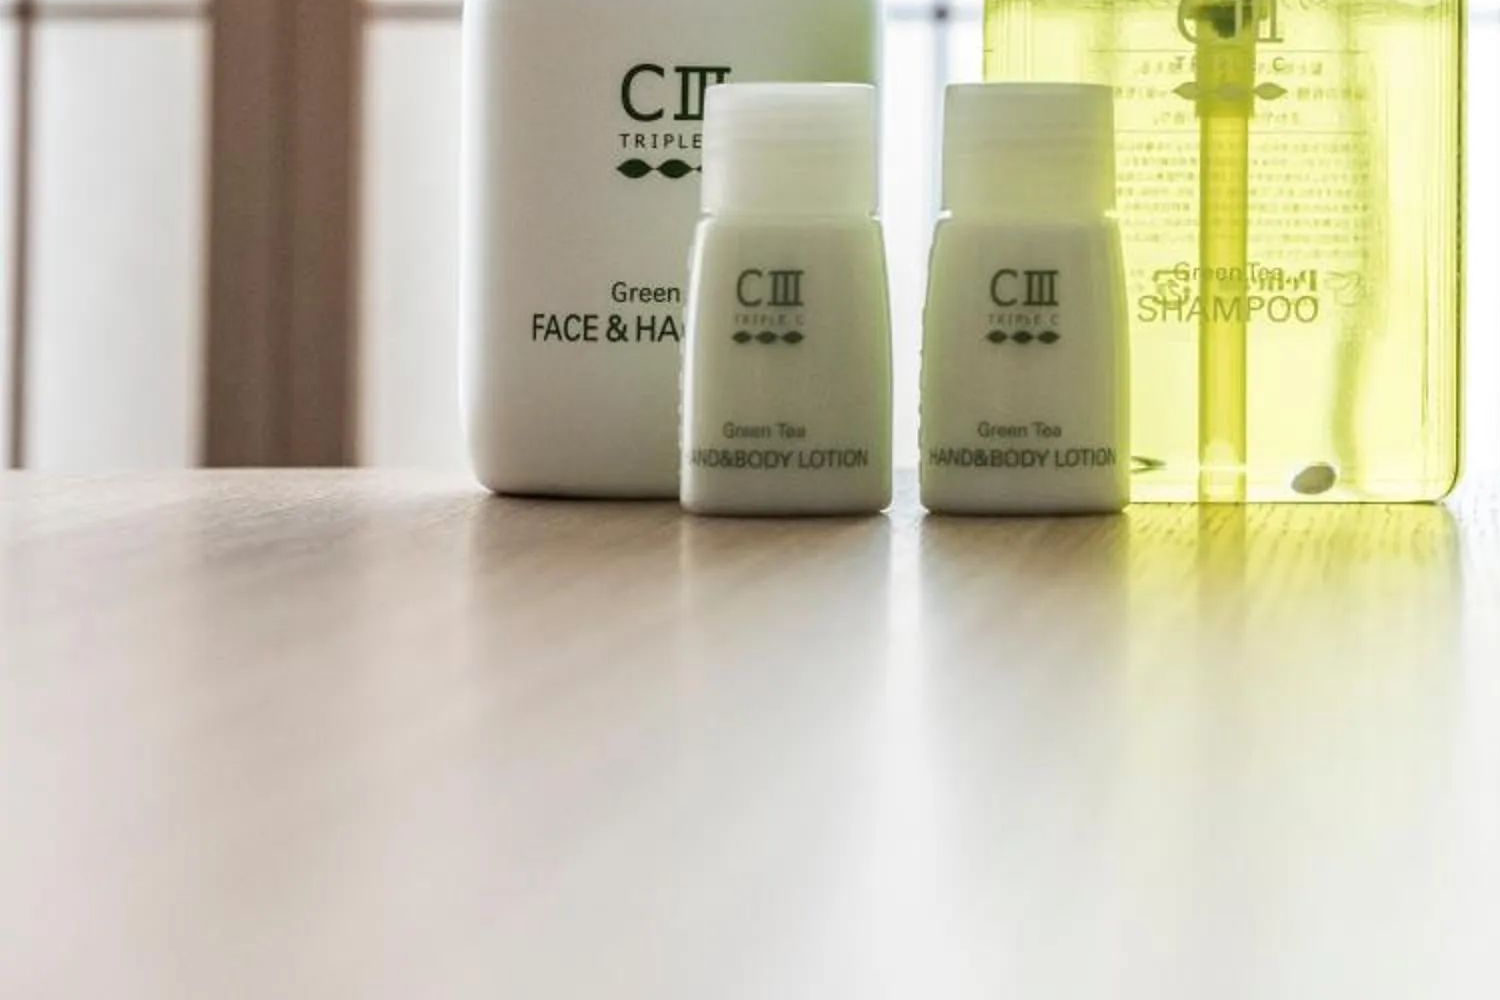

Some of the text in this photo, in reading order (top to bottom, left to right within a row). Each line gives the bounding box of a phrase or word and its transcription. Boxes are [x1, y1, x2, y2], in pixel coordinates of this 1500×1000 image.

[618, 133, 703, 149] TRIPLE
[1173, 261, 1243, 282] Green
[611, 281, 681, 303] Green
[1137, 294, 1319, 323] SHAMPOO
[532, 313, 685, 343] FACE & HA
[722, 421, 807, 439] Green Tea
[977, 421, 1063, 438] Green Tea
[798, 448, 869, 468] LOTION
[1055, 447, 1118, 468] LOTION
